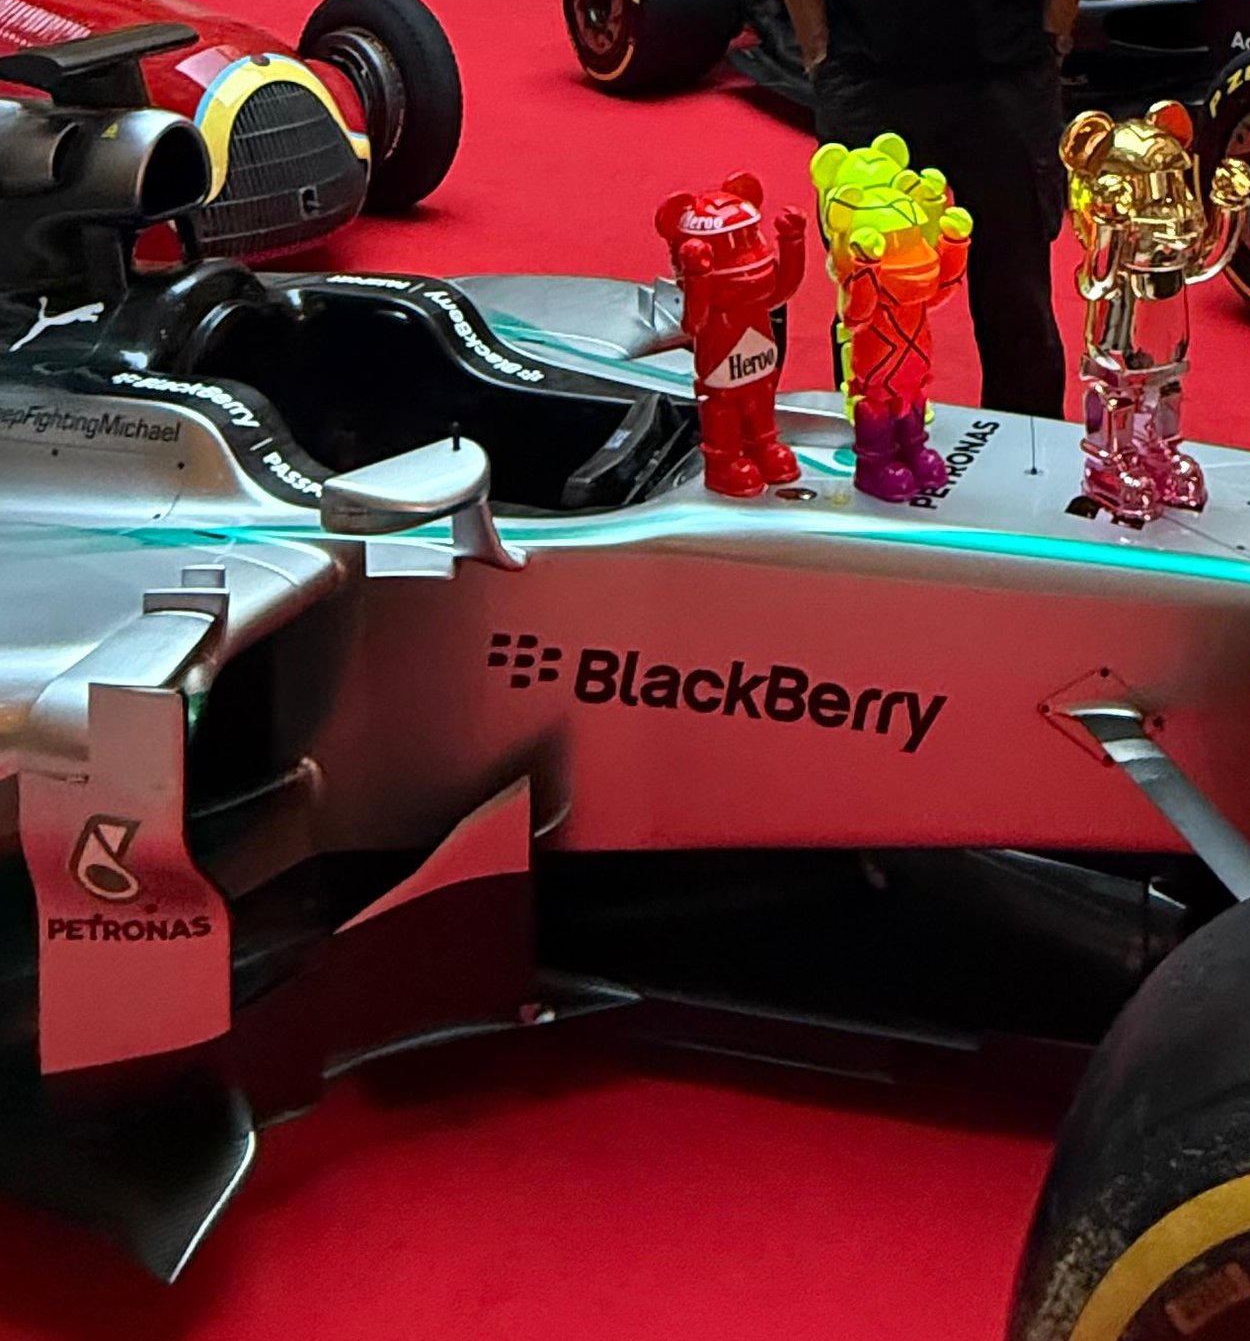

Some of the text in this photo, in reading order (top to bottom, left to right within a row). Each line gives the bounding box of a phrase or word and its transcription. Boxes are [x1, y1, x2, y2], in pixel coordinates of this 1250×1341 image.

[1209, 89, 1222, 120] P
[727, 346, 775, 381] Heroo
[573, 648, 948, 754] BlackBerry
[48, 913, 213, 942] PETRONAS
